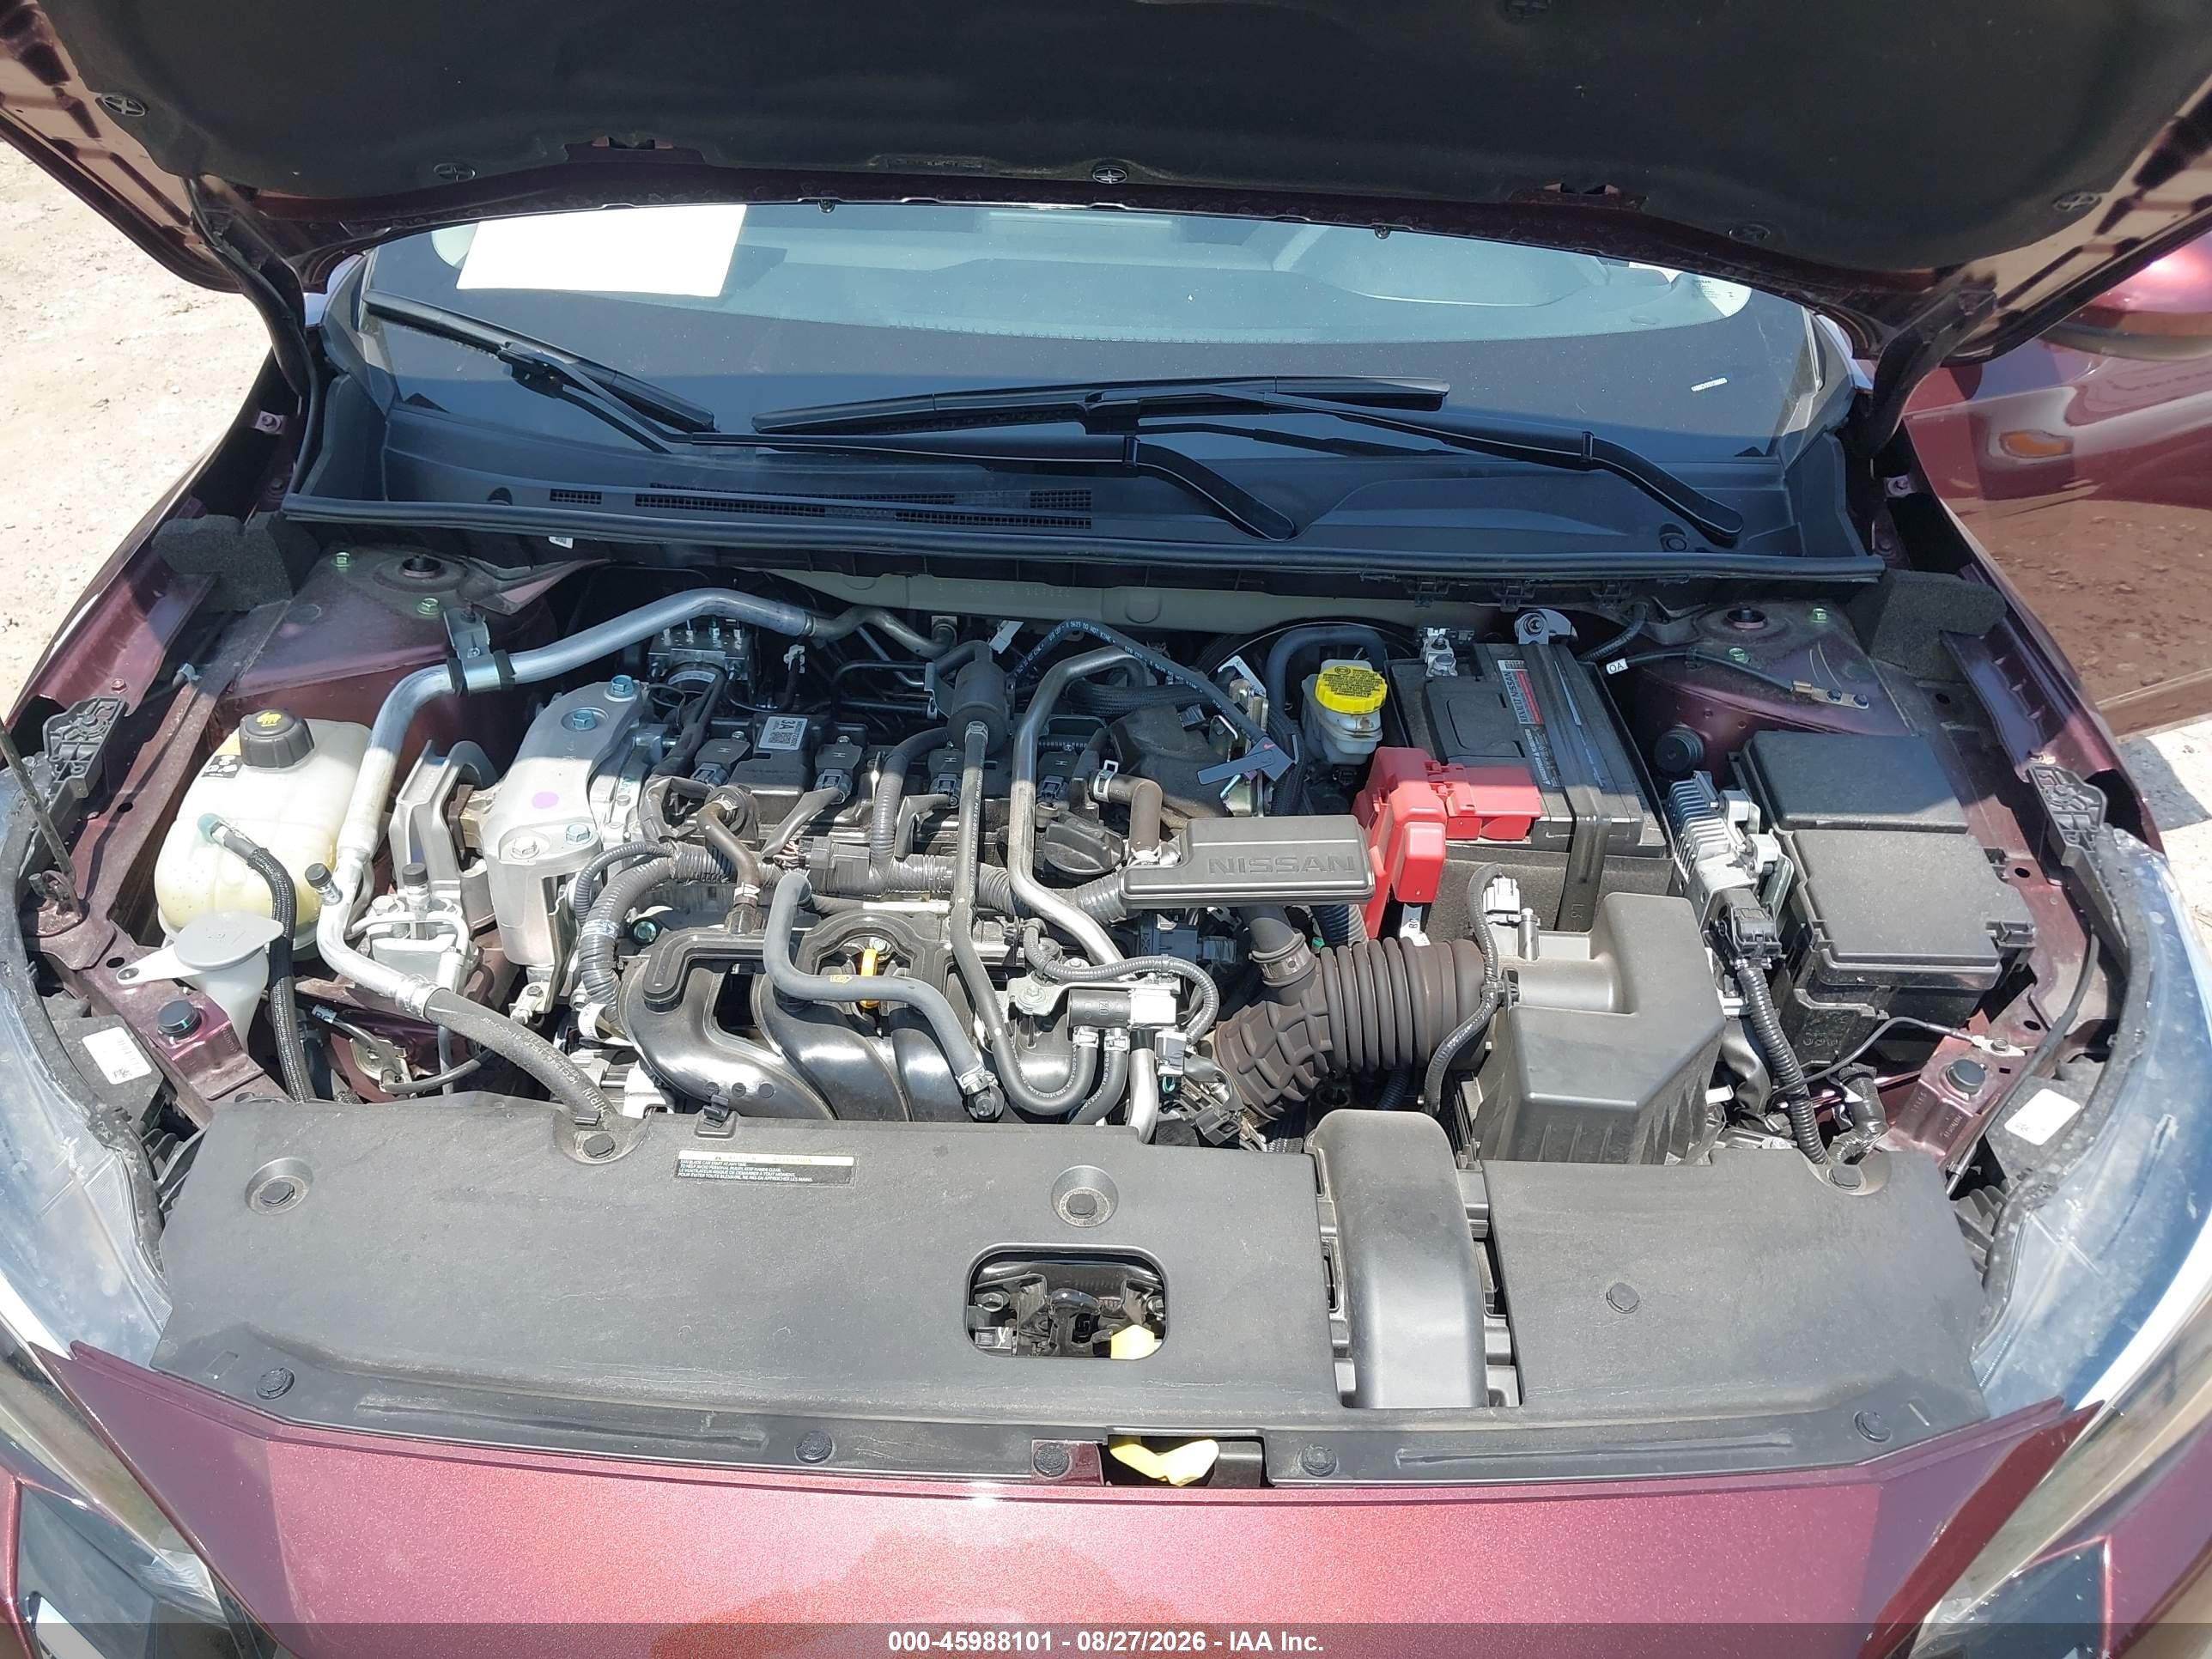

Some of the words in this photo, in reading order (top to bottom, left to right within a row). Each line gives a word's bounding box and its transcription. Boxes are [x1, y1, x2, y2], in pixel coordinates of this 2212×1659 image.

[1503, 671, 1519, 697] NISSAN
[779, 720, 795, 730] 3A
[1208, 855, 1355, 875] NISSAN
